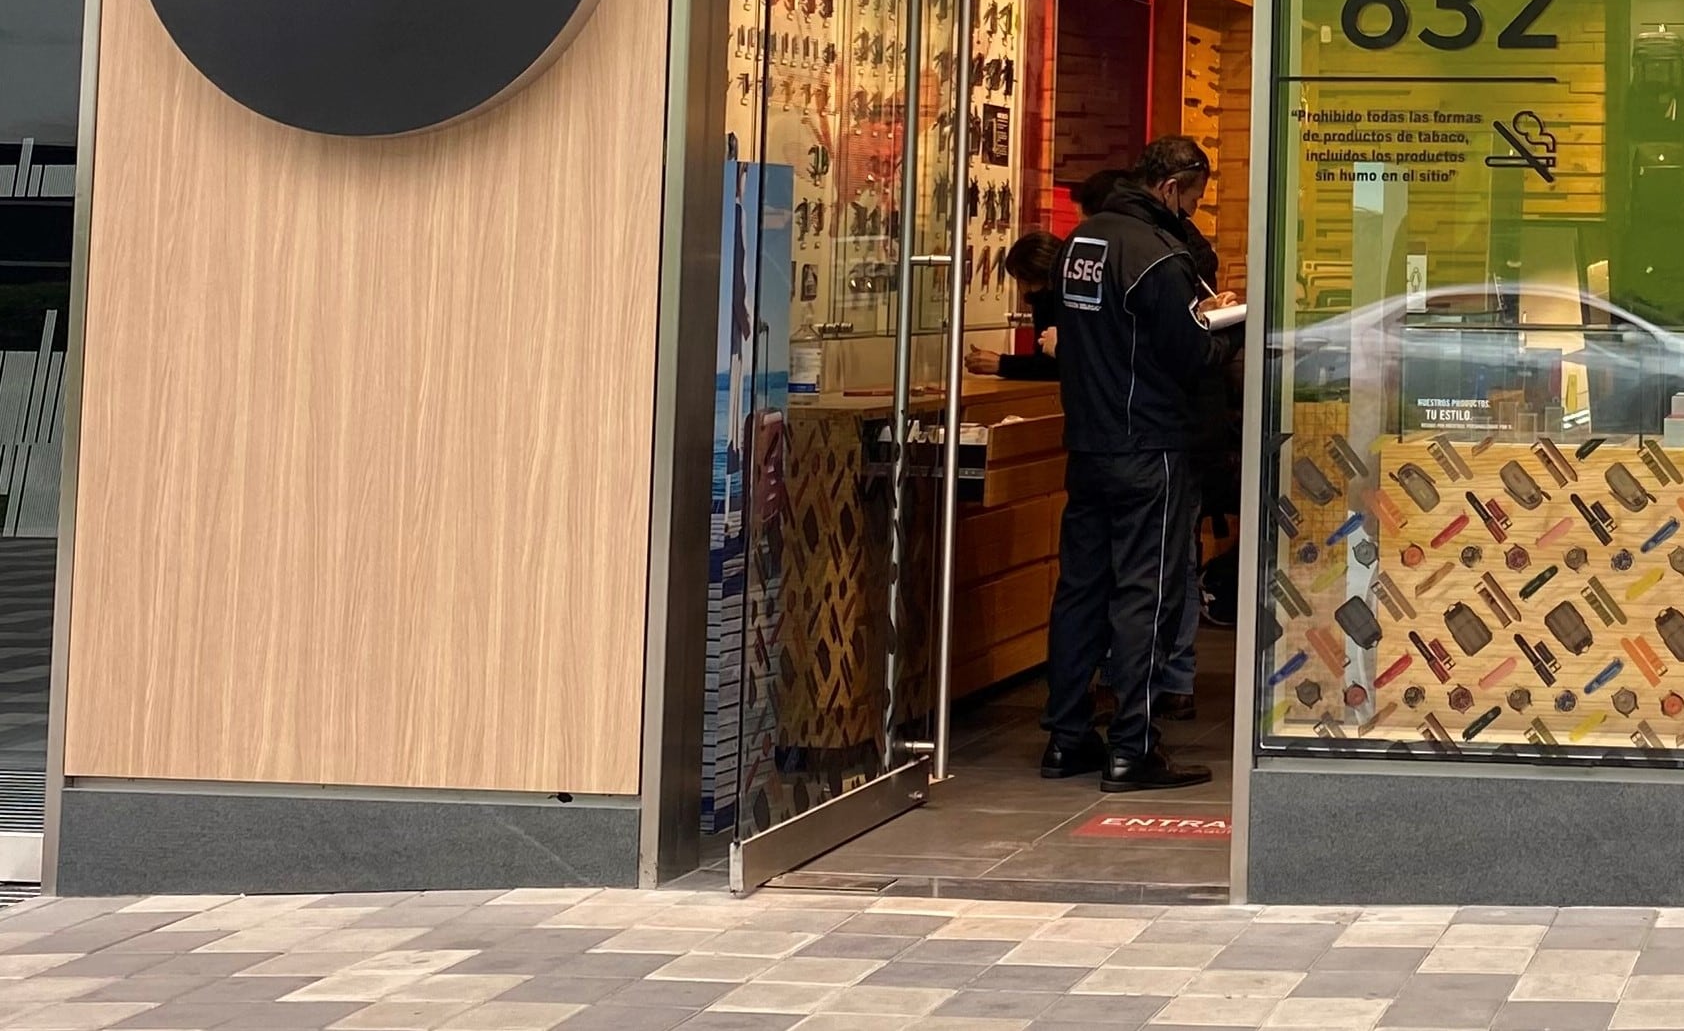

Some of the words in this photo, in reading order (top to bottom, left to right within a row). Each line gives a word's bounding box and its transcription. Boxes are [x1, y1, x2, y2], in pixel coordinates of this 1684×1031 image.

[1367, 110, 1404, 123] todas
[1410, 111, 1429, 123] las
[1433, 111, 1482, 124] formas
[1303, 130, 1317, 142] de
[1323, 130, 1392, 145] productos
[1397, 130, 1413, 143] de
[1418, 131, 1469, 145] tabaco,
[1306, 149, 1367, 162] incluidos
[1372, 149, 1391, 162] los
[1396, 150, 1465, 165] productos
[1315, 170, 1335, 182] sin
[1340, 169, 1377, 182] humo
[1381, 173, 1398, 182] en
[1403, 170, 1414, 182] el
[1425, 409, 1437, 421] TU
[1440, 410, 1473, 421] ESTILO.
[1100, 818, 1232, 828] ENTRA
